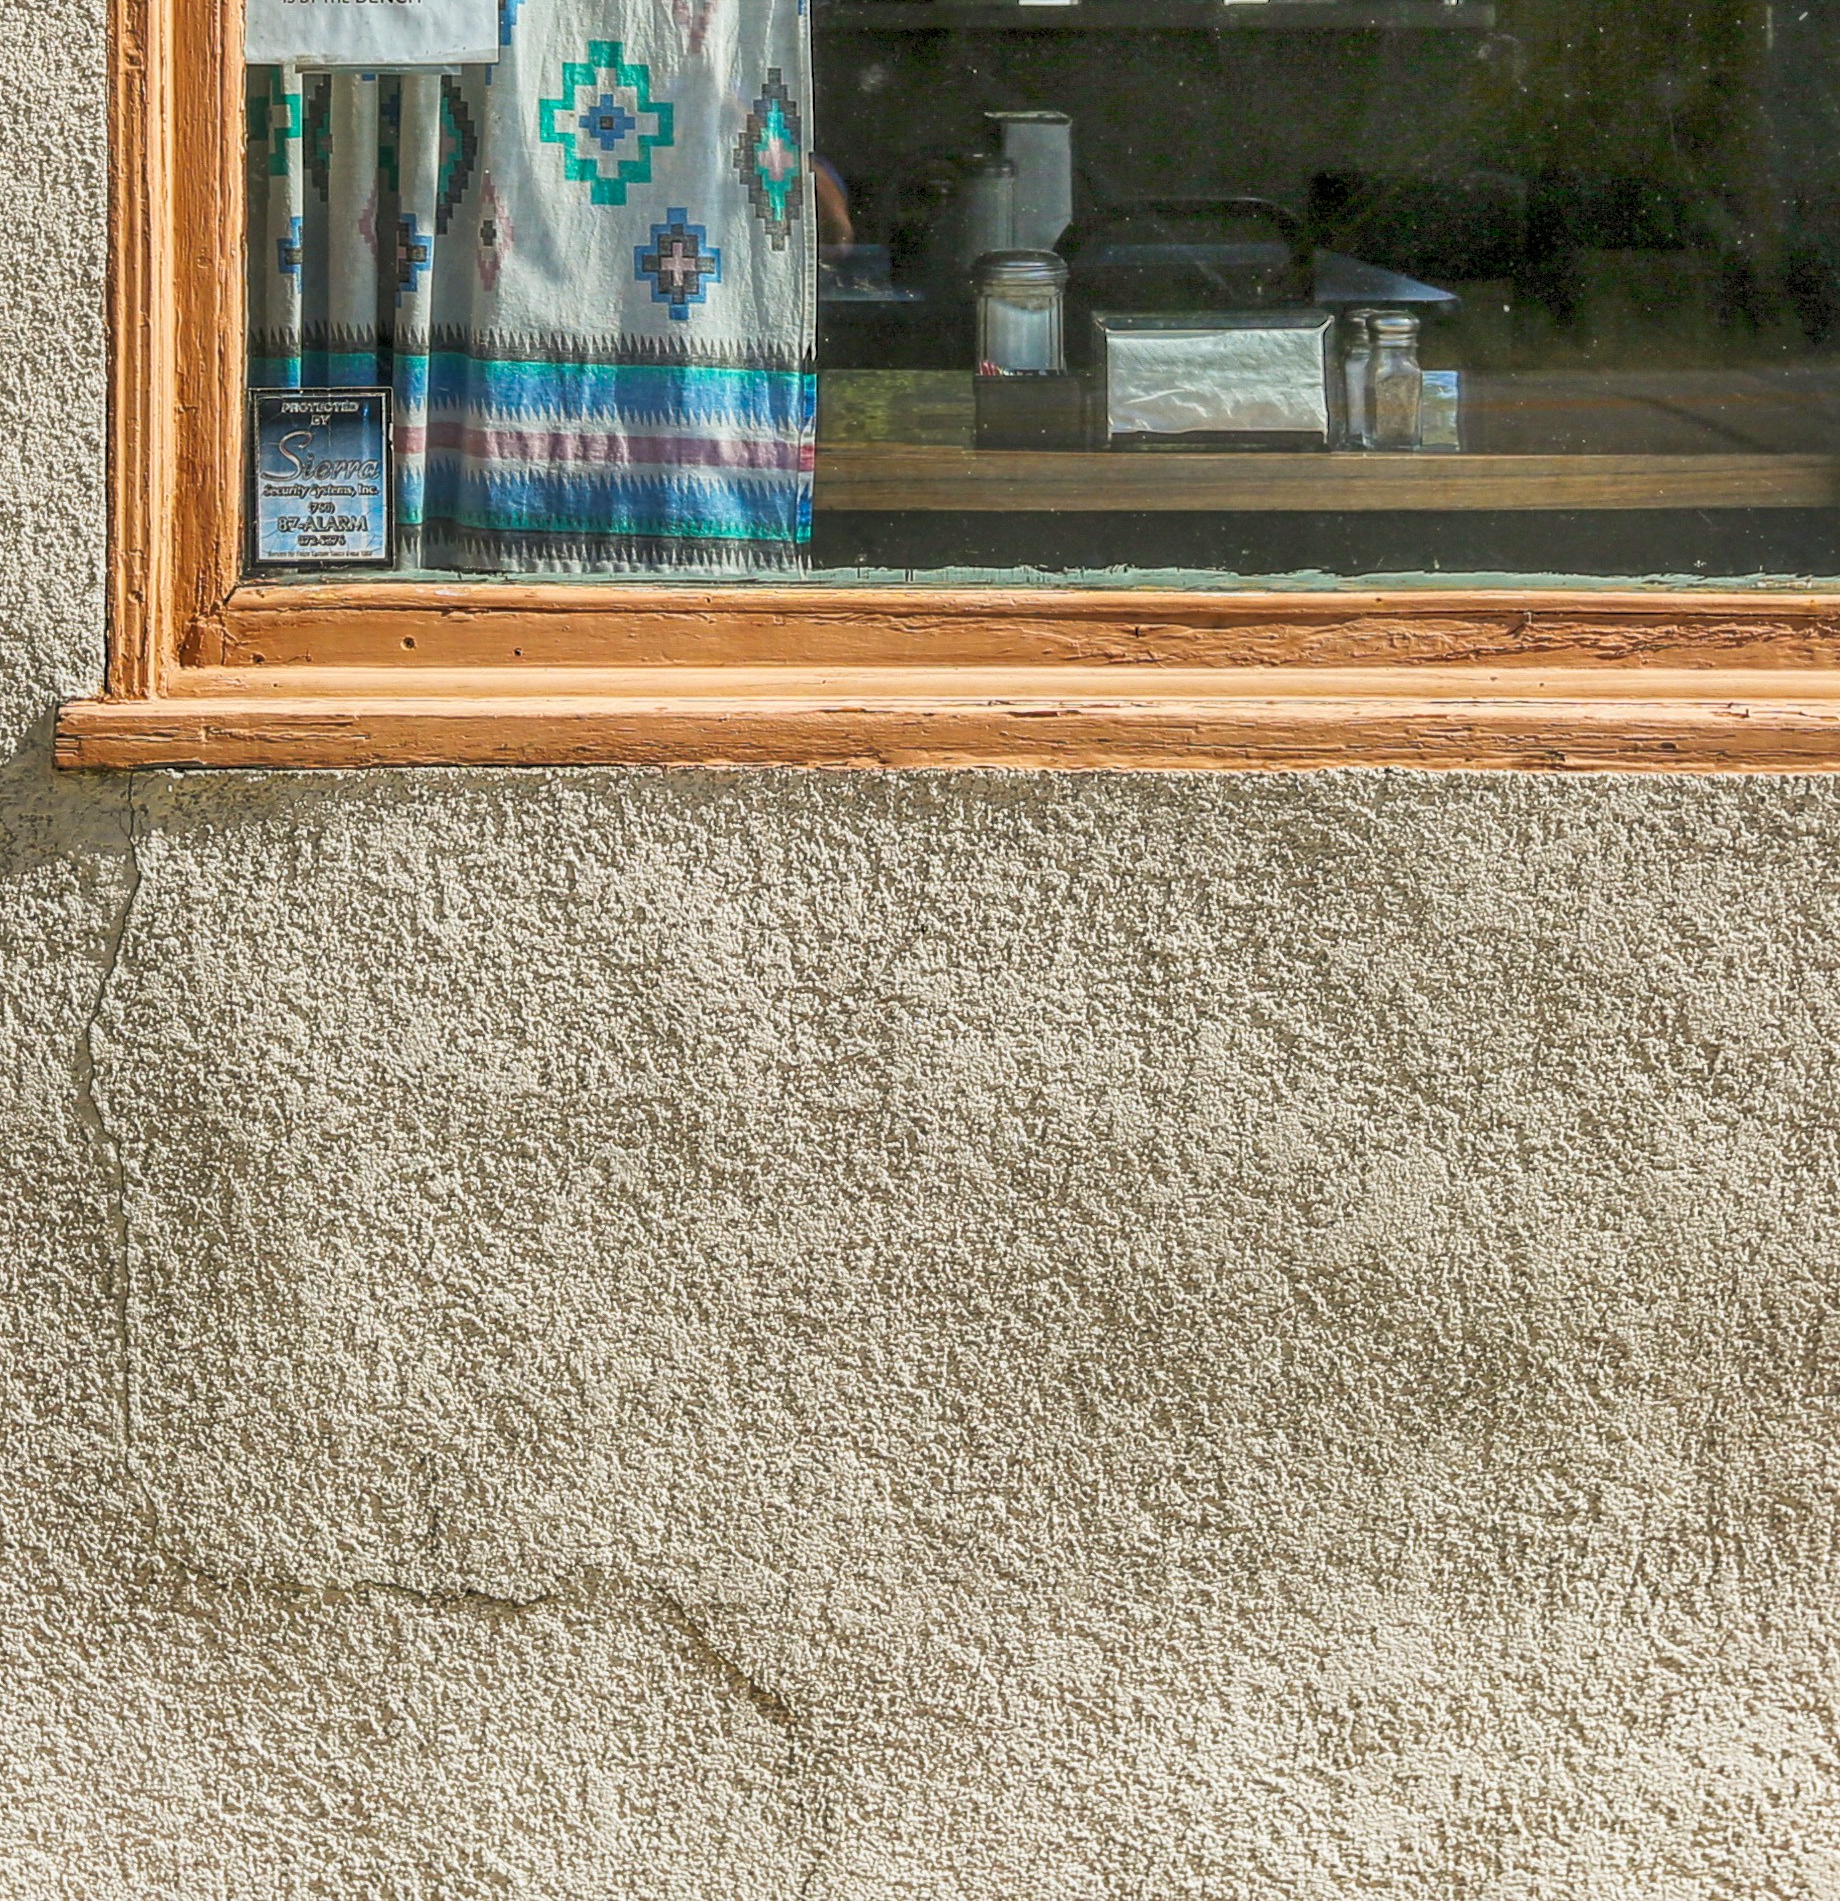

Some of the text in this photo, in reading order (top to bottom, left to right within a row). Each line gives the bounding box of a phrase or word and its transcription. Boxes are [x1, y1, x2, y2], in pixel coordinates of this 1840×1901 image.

[280, 401, 360, 414] PROTECTED
[310, 414, 331, 426] BY
[260, 430, 380, 482] Sierra
[263, 483, 380, 499] Security Systems, Inc.
[277, 515, 369, 533] 87-ALARM
